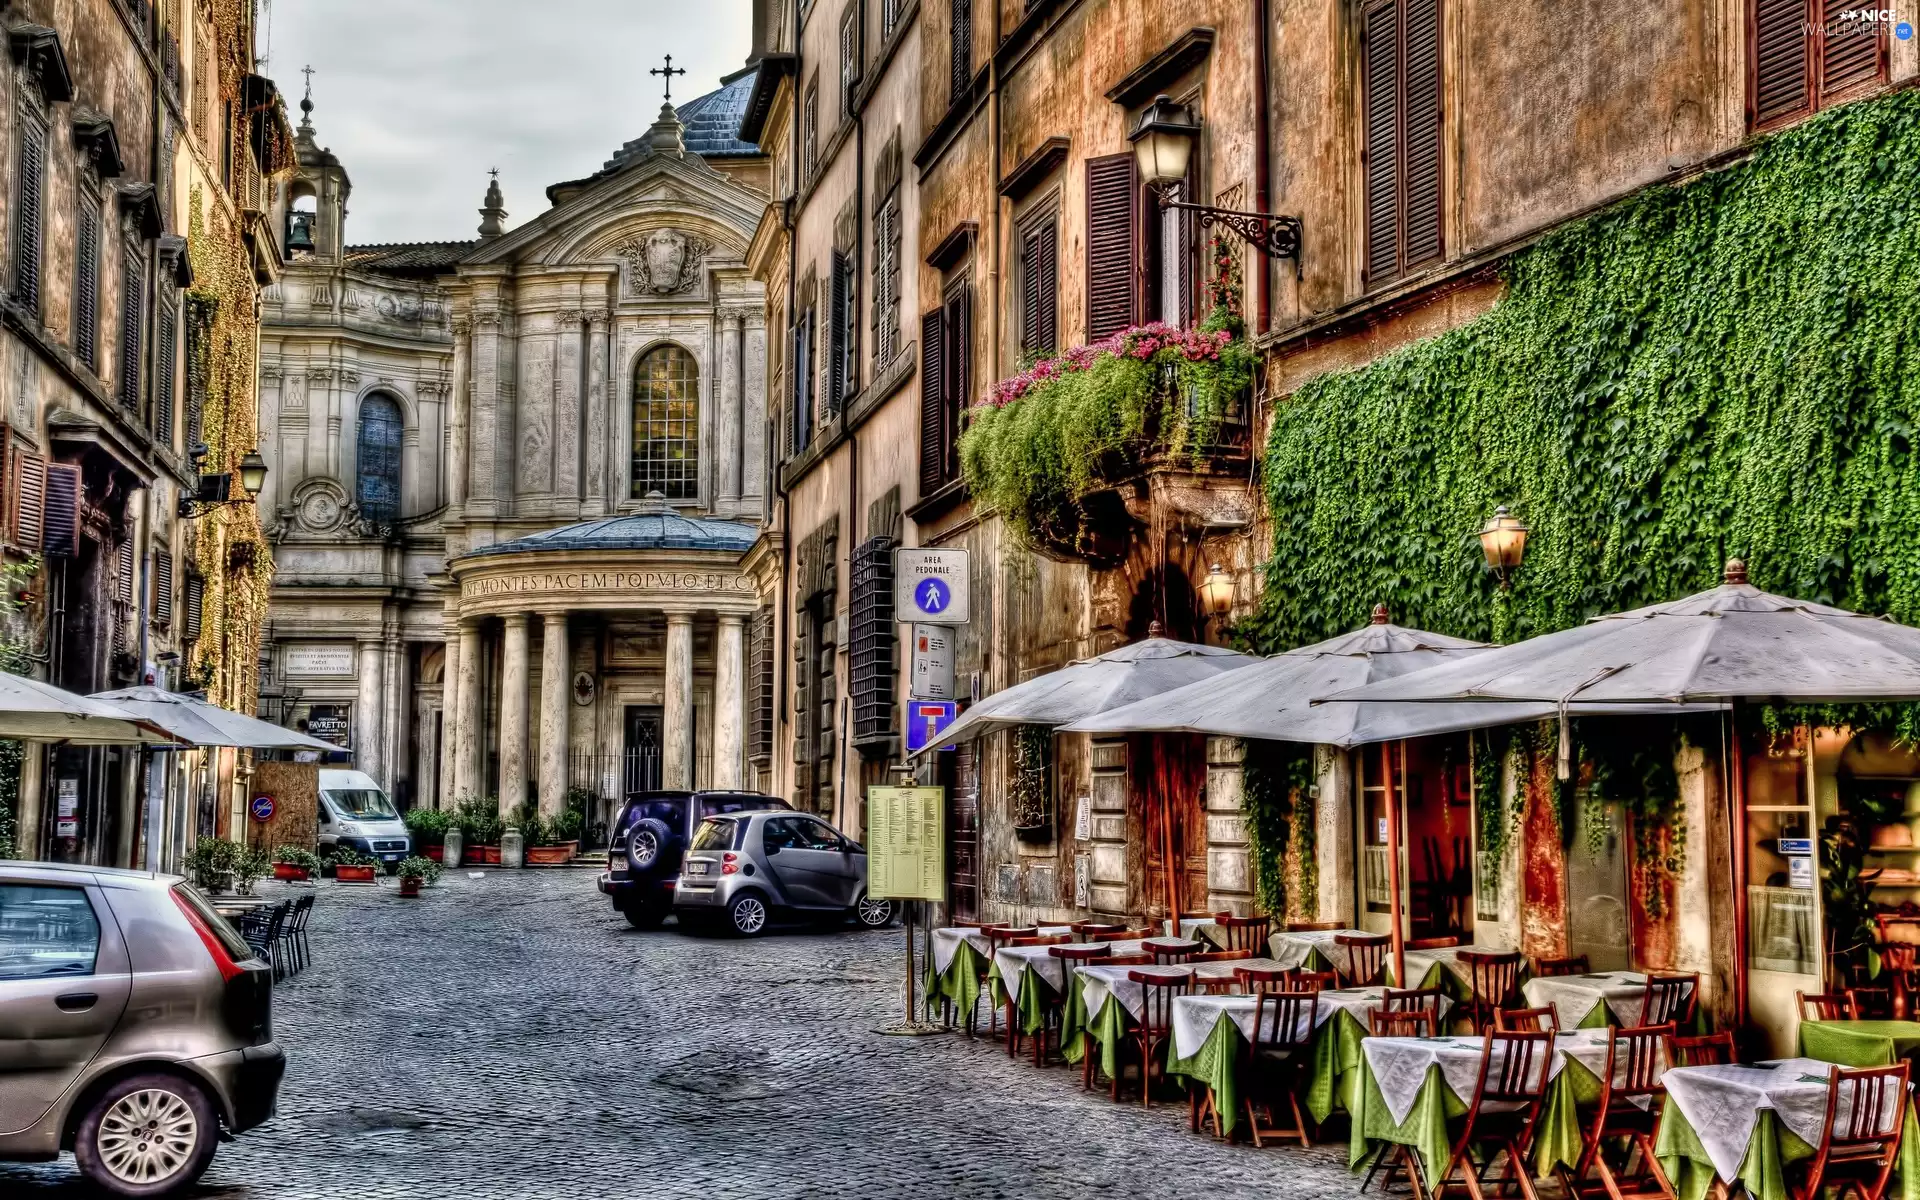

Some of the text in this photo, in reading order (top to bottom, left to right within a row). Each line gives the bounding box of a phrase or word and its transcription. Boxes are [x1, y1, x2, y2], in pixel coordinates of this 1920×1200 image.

[923, 556, 942, 564] AREA
[915, 566, 950, 574] PEDONALE
[480, 575, 537, 595] MONTES
[543, 573, 607, 589] PACEM
[309, 721, 347, 729] FAVRETTO
